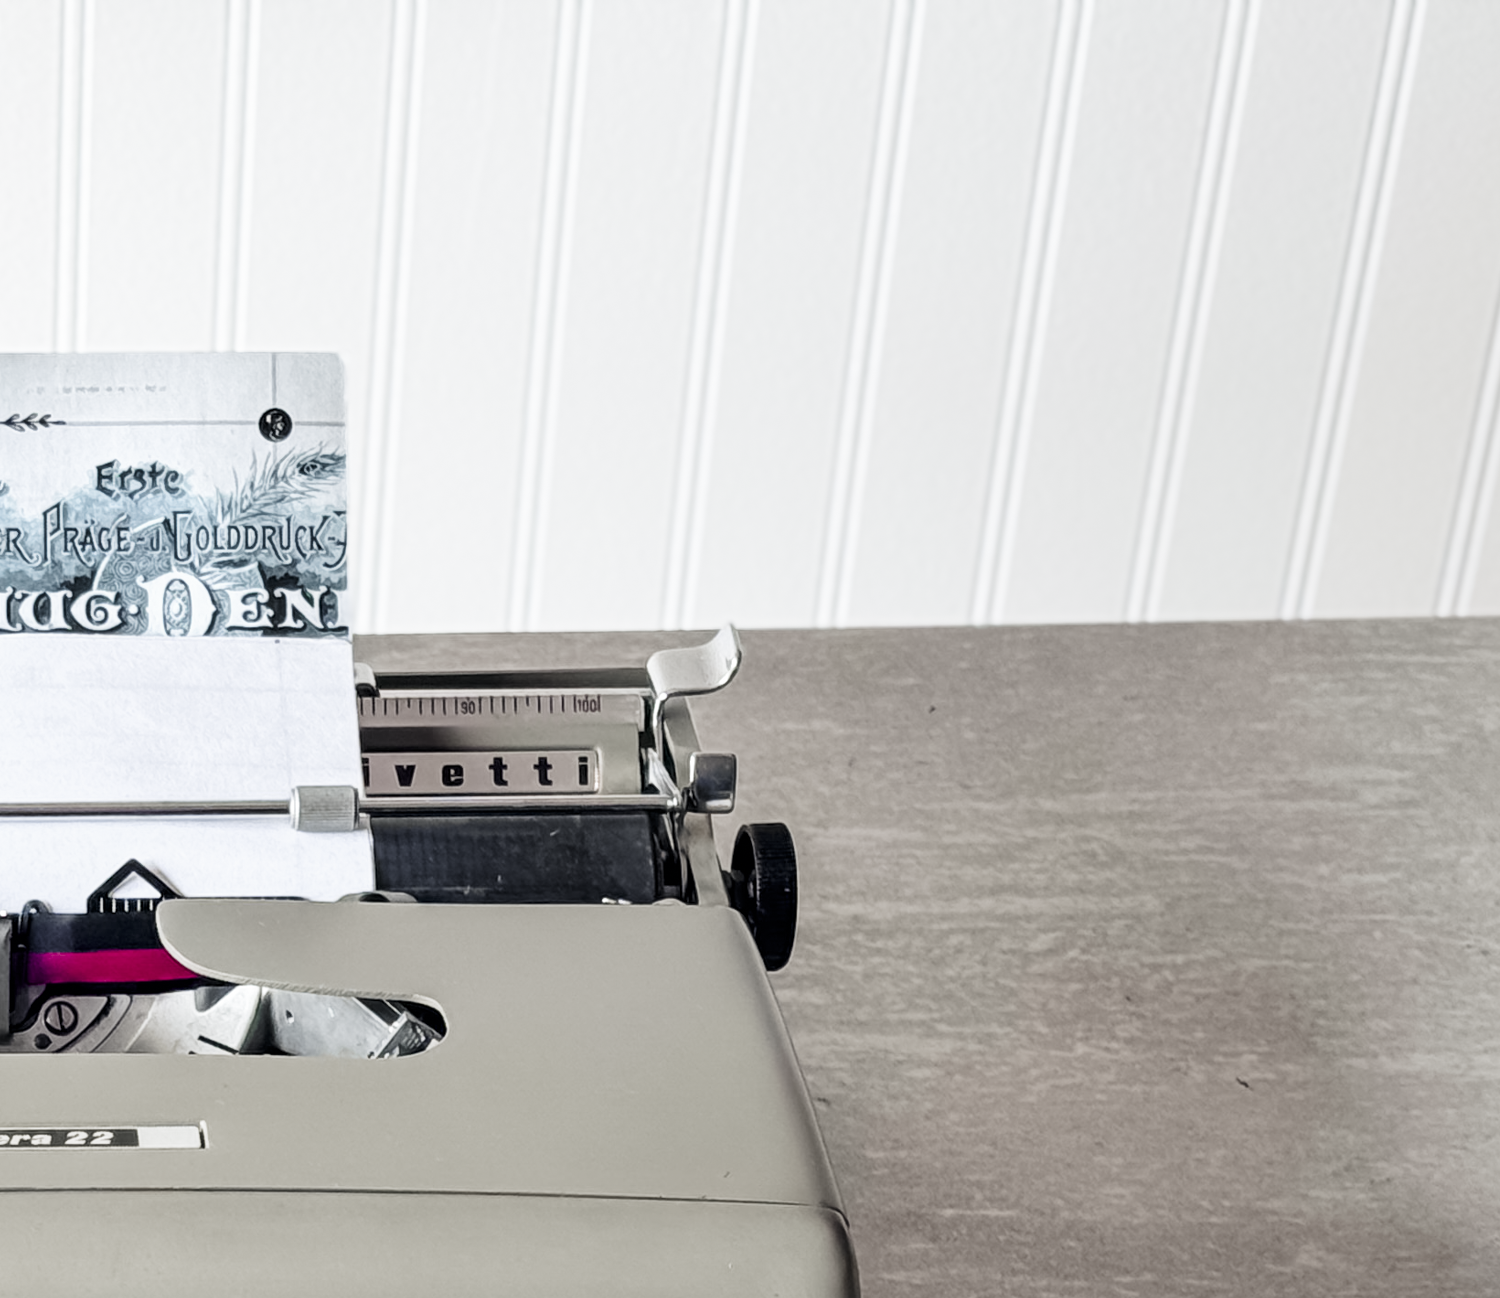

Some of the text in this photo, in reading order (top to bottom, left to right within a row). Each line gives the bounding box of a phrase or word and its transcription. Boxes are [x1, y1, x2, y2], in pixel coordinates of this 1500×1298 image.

[94, 459, 182, 499] Erste
[137, 571, 348, 637] DEN
[460, 700, 476, 715] 90
[361, 756, 589, 788] ivetti
[64, 1130, 115, 1146] 22
